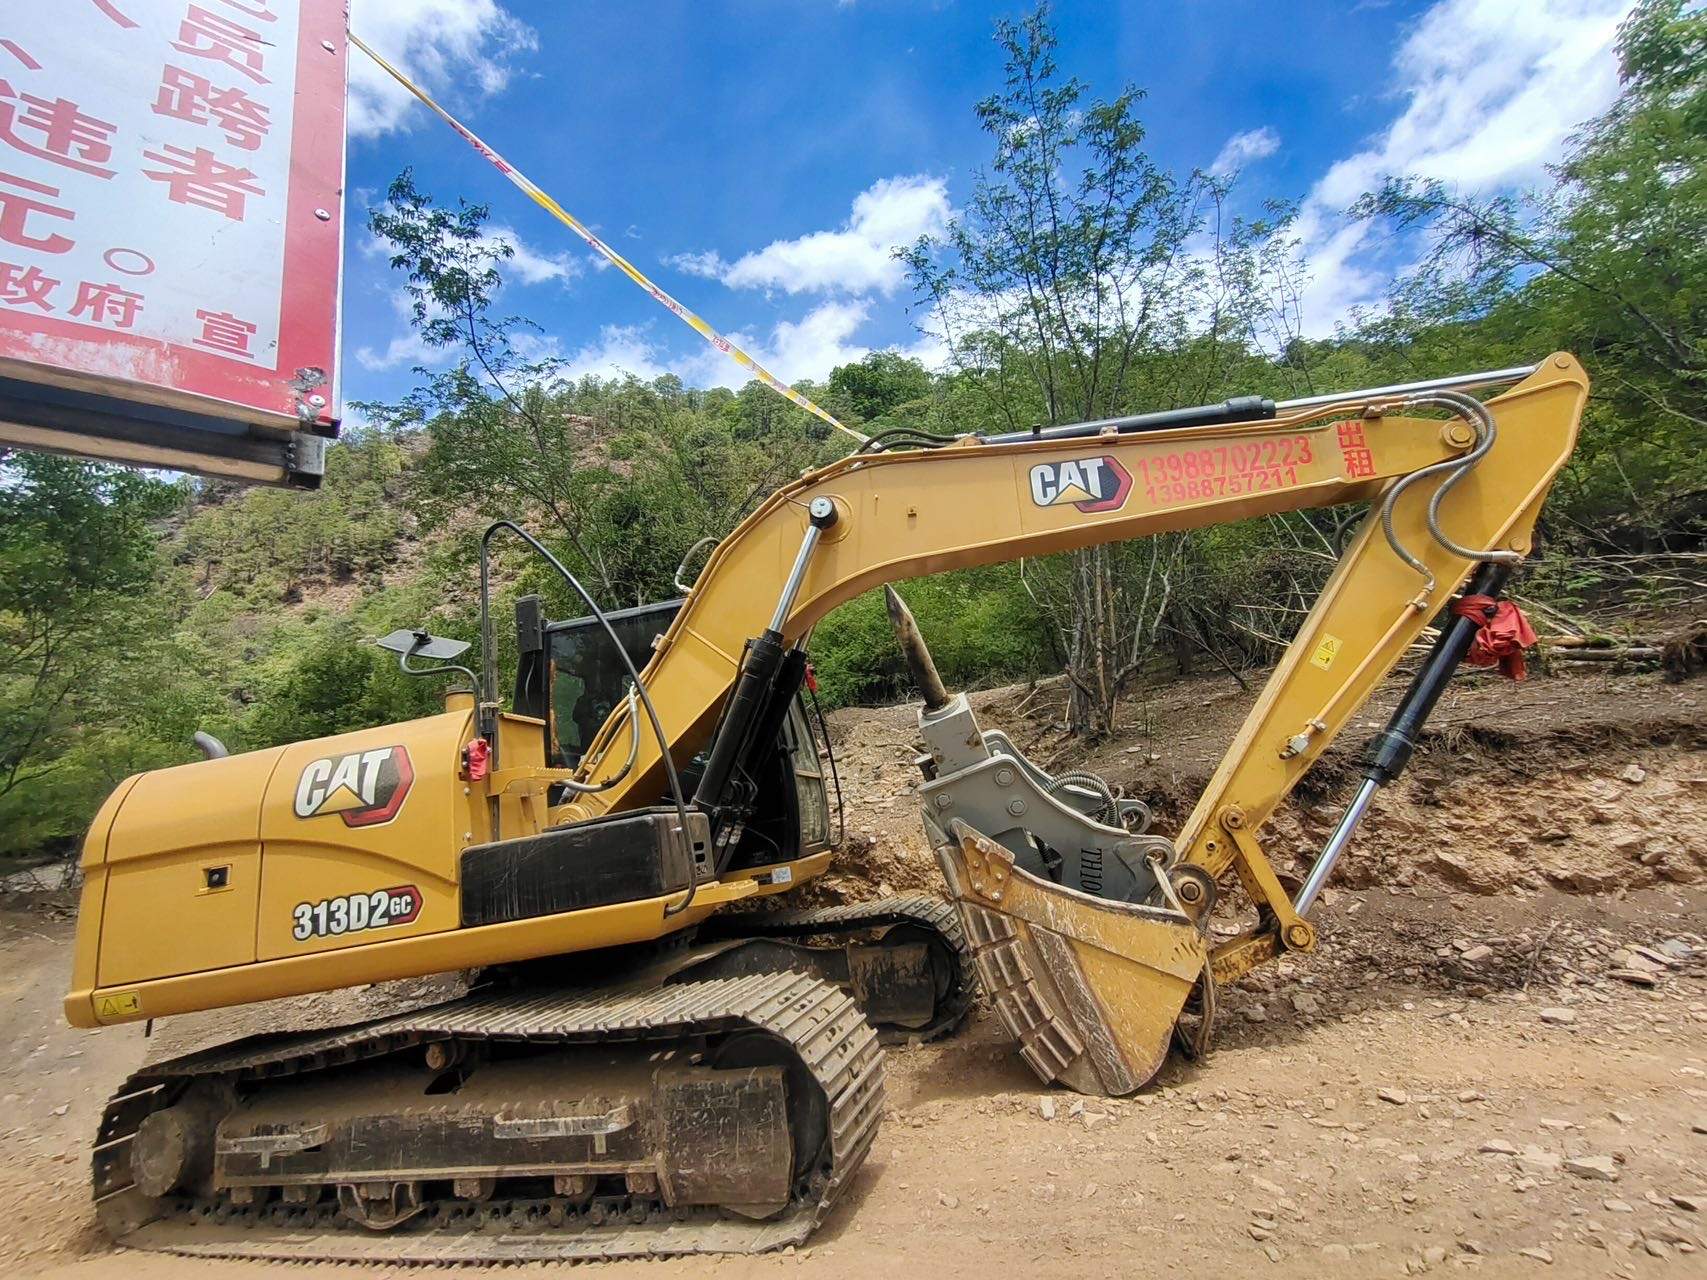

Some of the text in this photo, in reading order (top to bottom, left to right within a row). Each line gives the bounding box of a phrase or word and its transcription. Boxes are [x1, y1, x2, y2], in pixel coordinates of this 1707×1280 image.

[0, 261, 257, 359] 政府 宣
[1138, 435, 1313, 486] 13988702223
[1337, 421, 1377, 479] 出租
[1030, 458, 1104, 506] CAT
[1146, 466, 1298, 505] 13988757211
[295, 748, 392, 817] CAT
